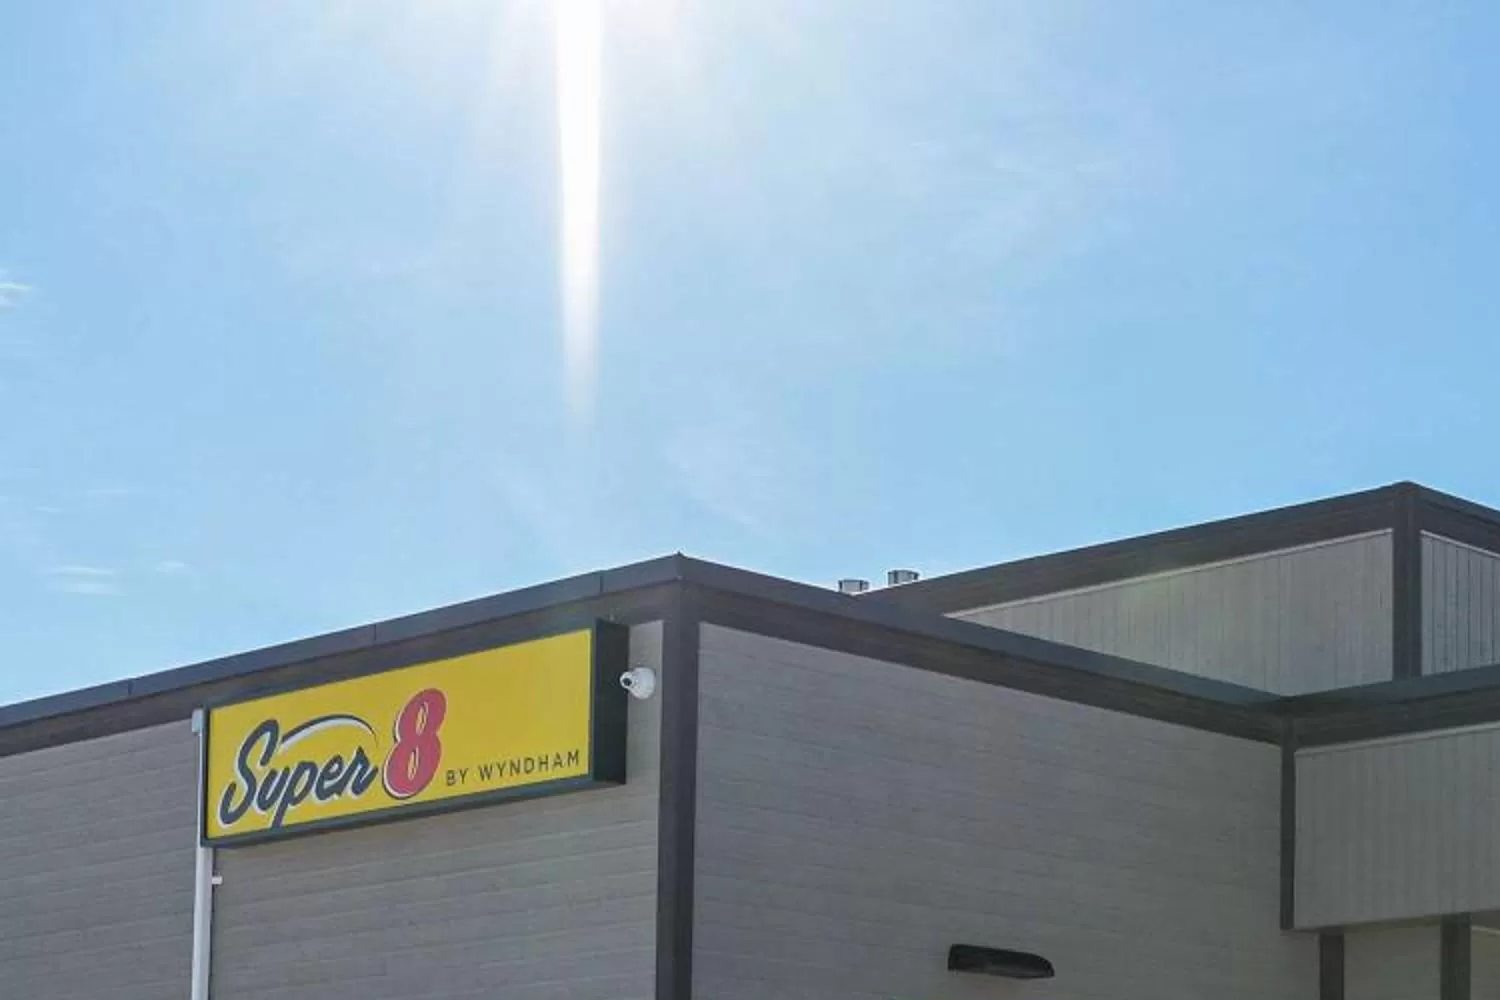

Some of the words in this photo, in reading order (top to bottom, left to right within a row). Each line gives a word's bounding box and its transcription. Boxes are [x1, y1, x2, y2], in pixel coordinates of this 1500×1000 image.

[218, 718, 379, 829] Super
[382, 687, 448, 799] 8
[445, 767, 469, 787] BY
[478, 749, 580, 782] WYNDHAM
